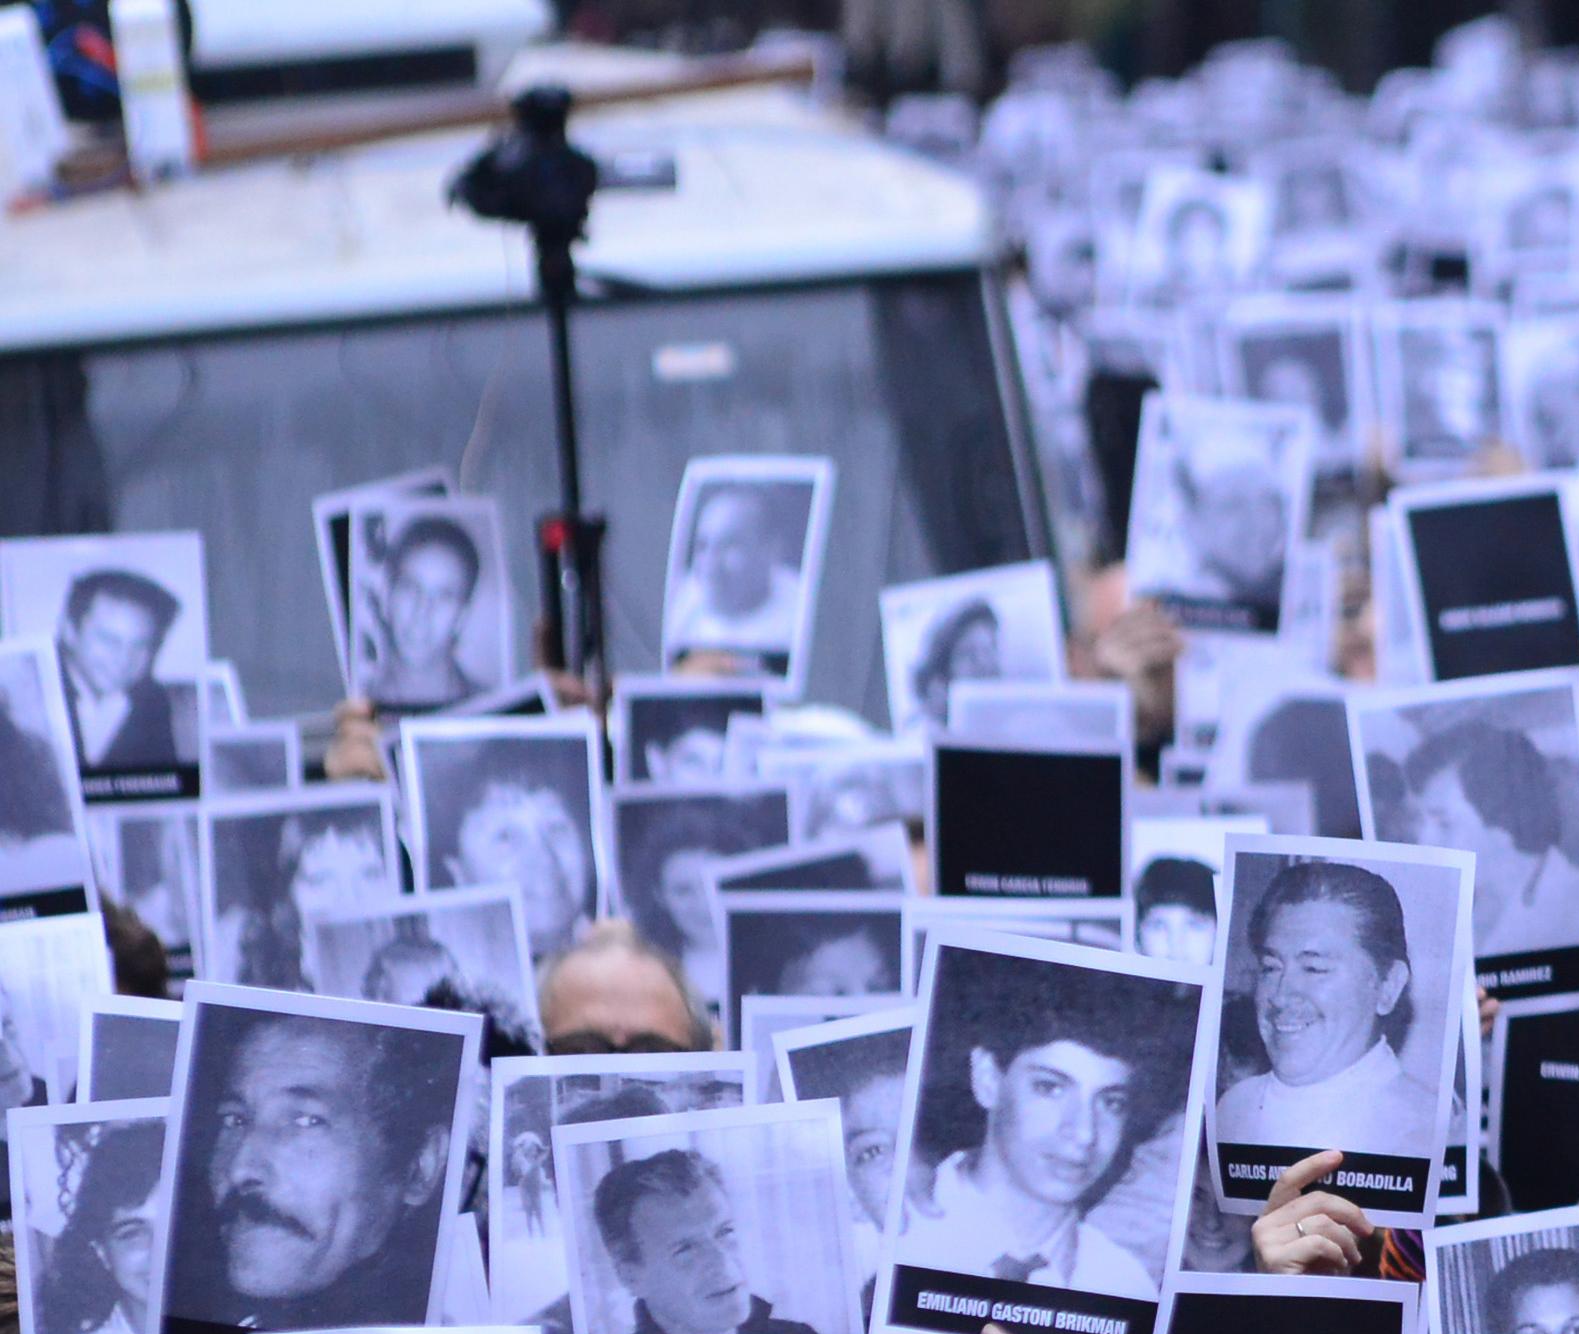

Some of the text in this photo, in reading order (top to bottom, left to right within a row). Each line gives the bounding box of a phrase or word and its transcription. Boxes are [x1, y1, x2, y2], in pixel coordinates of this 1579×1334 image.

[1500, 966, 1552, 987] RAMIREZ
[1540, 1061, 1579, 1081] ERWIN
[1228, 1163, 1267, 1180] CARLOS
[1337, 1171, 1414, 1192] BOBADILLA
[917, 1292, 988, 1319] EMILIANO
[991, 1303, 1052, 1327] GASTON
